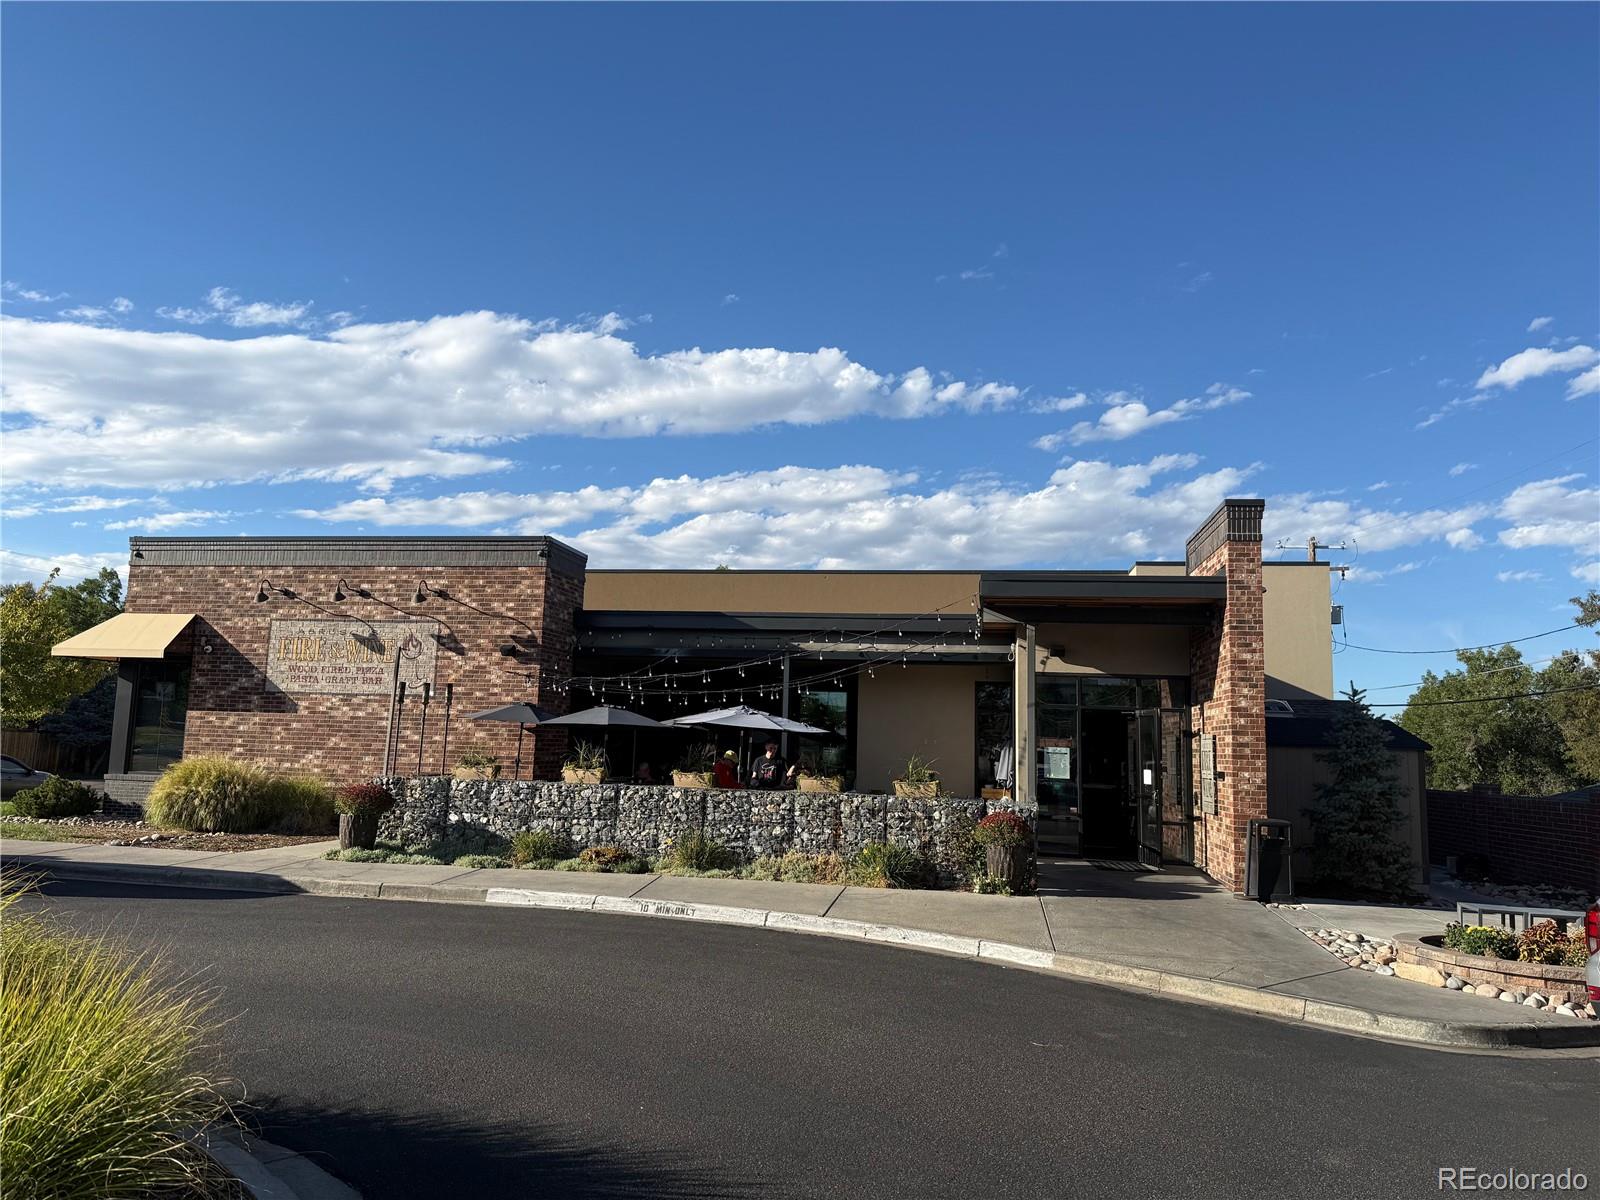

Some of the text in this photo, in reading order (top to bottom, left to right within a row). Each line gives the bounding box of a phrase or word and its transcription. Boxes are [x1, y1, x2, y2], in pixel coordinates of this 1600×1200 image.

[277, 636, 325, 662] FIRE
[328, 642, 345, 661] &
[288, 664, 318, 674] WOOD
[355, 666, 385, 676] PIZZA
[289, 675, 320, 685] PASTA
[361, 676, 383, 685] BAR
[674, 906, 696, 917] ONLY
